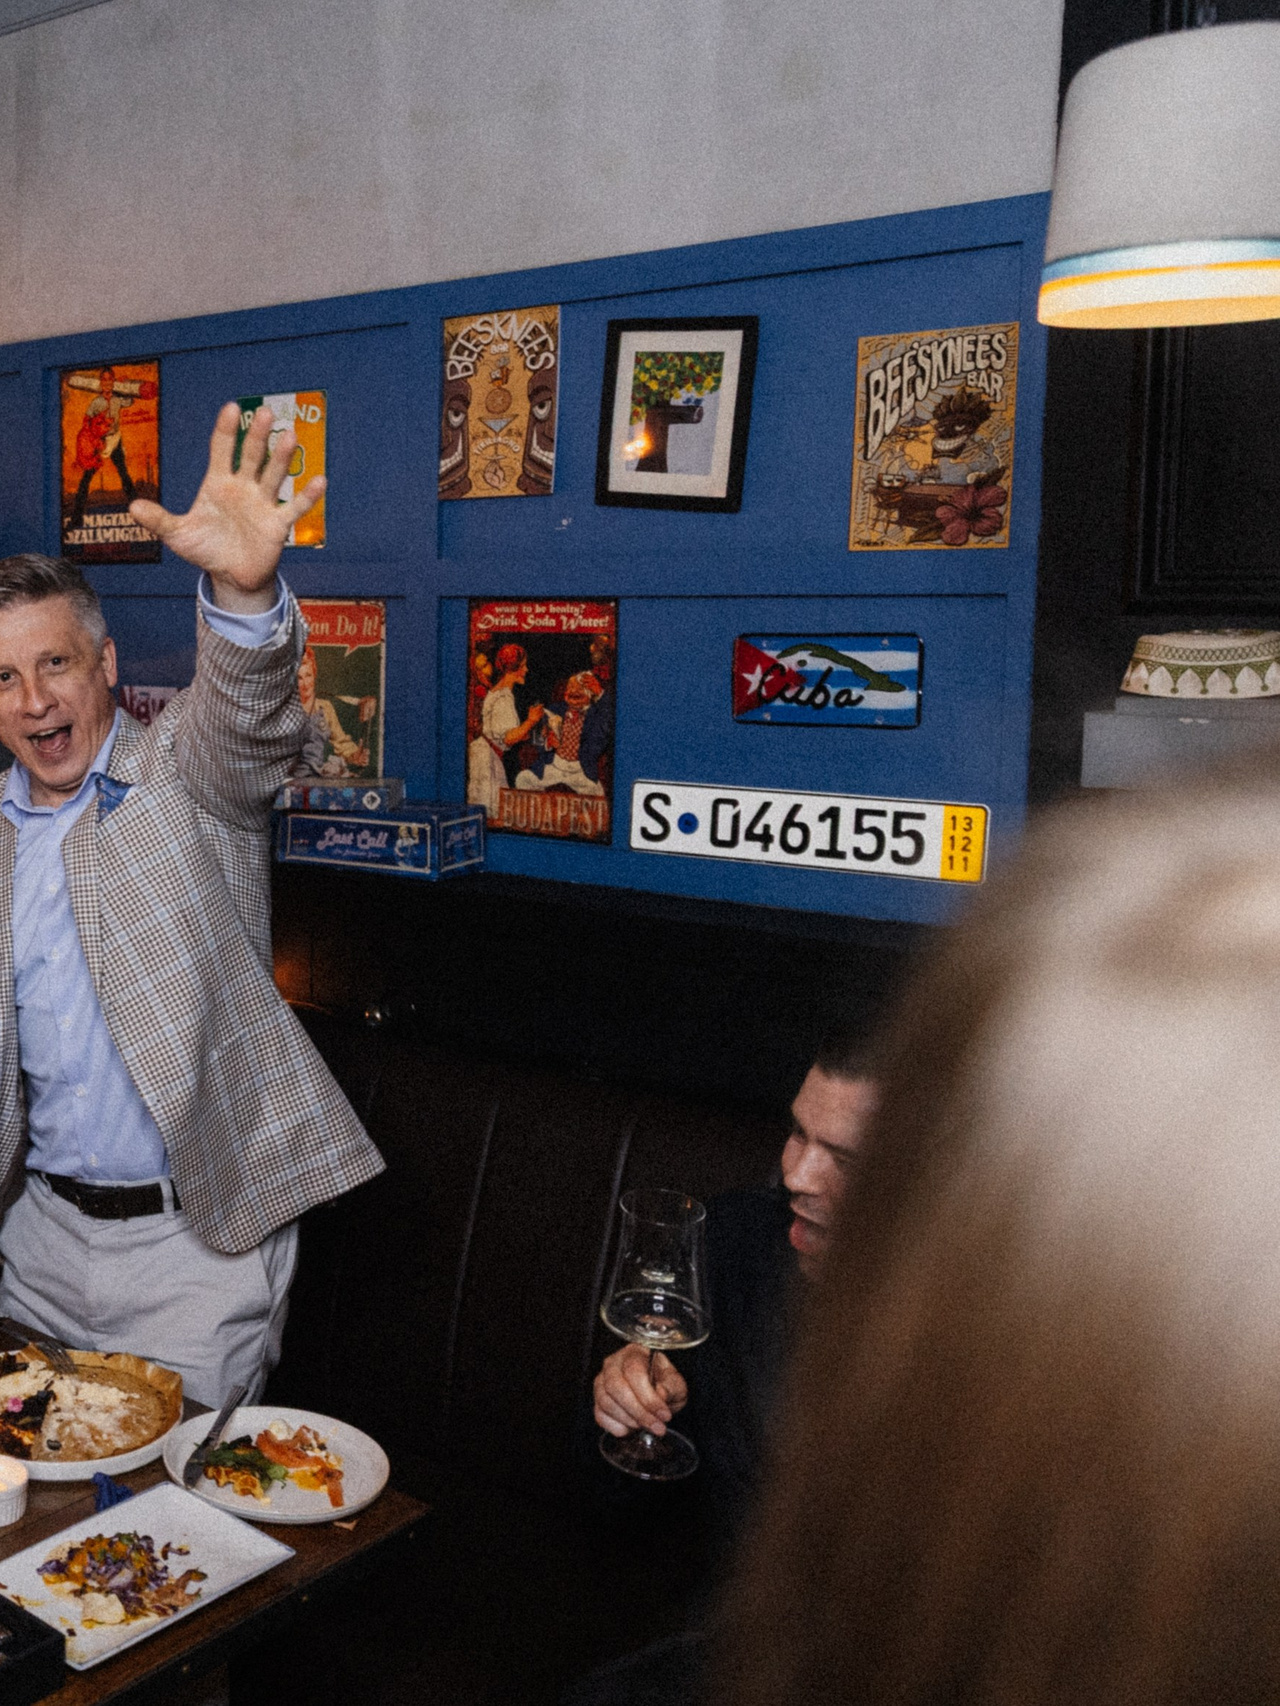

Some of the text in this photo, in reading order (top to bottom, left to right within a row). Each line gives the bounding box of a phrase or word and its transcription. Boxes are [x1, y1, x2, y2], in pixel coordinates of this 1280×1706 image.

[967, 370, 1005, 402] BAR
[240, 403, 322, 431] IRAND
[336, 614, 358, 636] Do
[477, 614, 610, 631] Drink Soda Water!
[758, 662, 865, 710] Cuba
[503, 791, 609, 837] BUDAPEST
[951, 815, 973, 832] 13
[640, 791, 927, 866] S 046155
[950, 835, 972, 852] 12
[949, 855, 968, 872] 11
